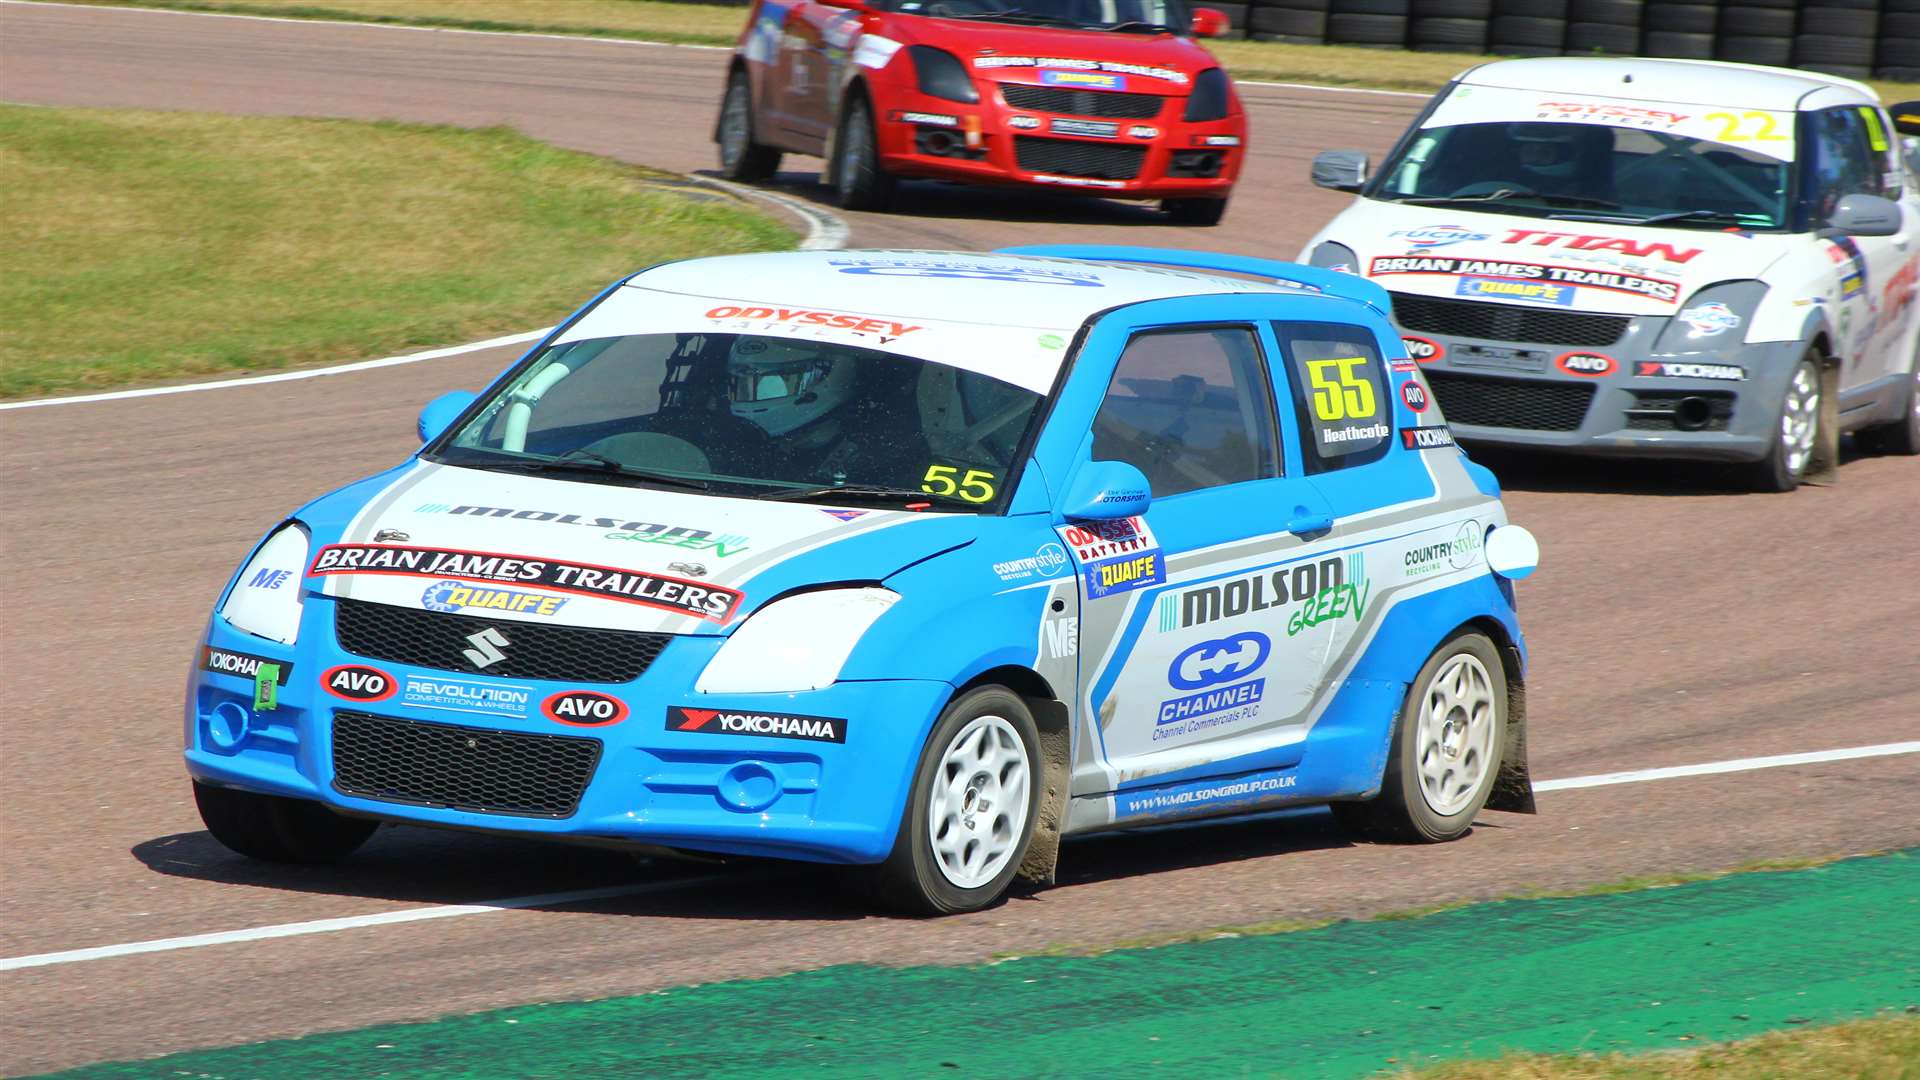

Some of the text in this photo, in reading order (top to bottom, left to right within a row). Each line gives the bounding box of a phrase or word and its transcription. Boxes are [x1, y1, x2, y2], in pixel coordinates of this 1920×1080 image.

[1704, 111, 1790, 142] 22
[1388, 230, 1491, 241] FUCHS
[1372, 257, 1454, 274] BRIAN
[1454, 259, 1544, 279] JAMES
[1548, 267, 1677, 300] TRAILERS
[1478, 280, 1562, 300] QUAIFE
[705, 306, 923, 337] ODYSSEY
[1403, 340, 1435, 356] VO
[1565, 356, 1609, 371] AVO
[1661, 363, 1744, 380] YOKOHAMA
[1305, 357, 1376, 421] 55
[1405, 387, 1425, 403] AVO
[1323, 424, 1389, 444] Heathcote
[921, 465, 994, 503] 55
[604, 531, 749, 558] GREEN
[1065, 517, 1142, 547] ODYSSEY
[1079, 536, 1148, 561] BATTERY
[1405, 541, 1453, 566] COUNTRY
[992, 556, 1038, 575] COUNTRY
[1101, 555, 1156, 586] QUAIFE
[316, 549, 426, 570] BRIAN
[420, 552, 546, 580] JAMES
[554, 565, 733, 614] TRAILERS
[447, 587, 565, 616] QUAIFE
[1287, 578, 1370, 637] GREEN
[210, 650, 279, 681] YOKOHA
[331, 670, 385, 694] AVO
[405, 681, 528, 704] REVOLUTION
[404, 693, 527, 712] COMPETITION WHEELS
[555, 697, 614, 719] AVO
[1160, 684, 1262, 722] CHANNEL
[717, 713, 835, 739] YOKOHAMA
[1152, 704, 1260, 741] Channel Commercials PLC
[1129, 775, 1297, 812] WWW.MOLSONGROUP.CO.UK
